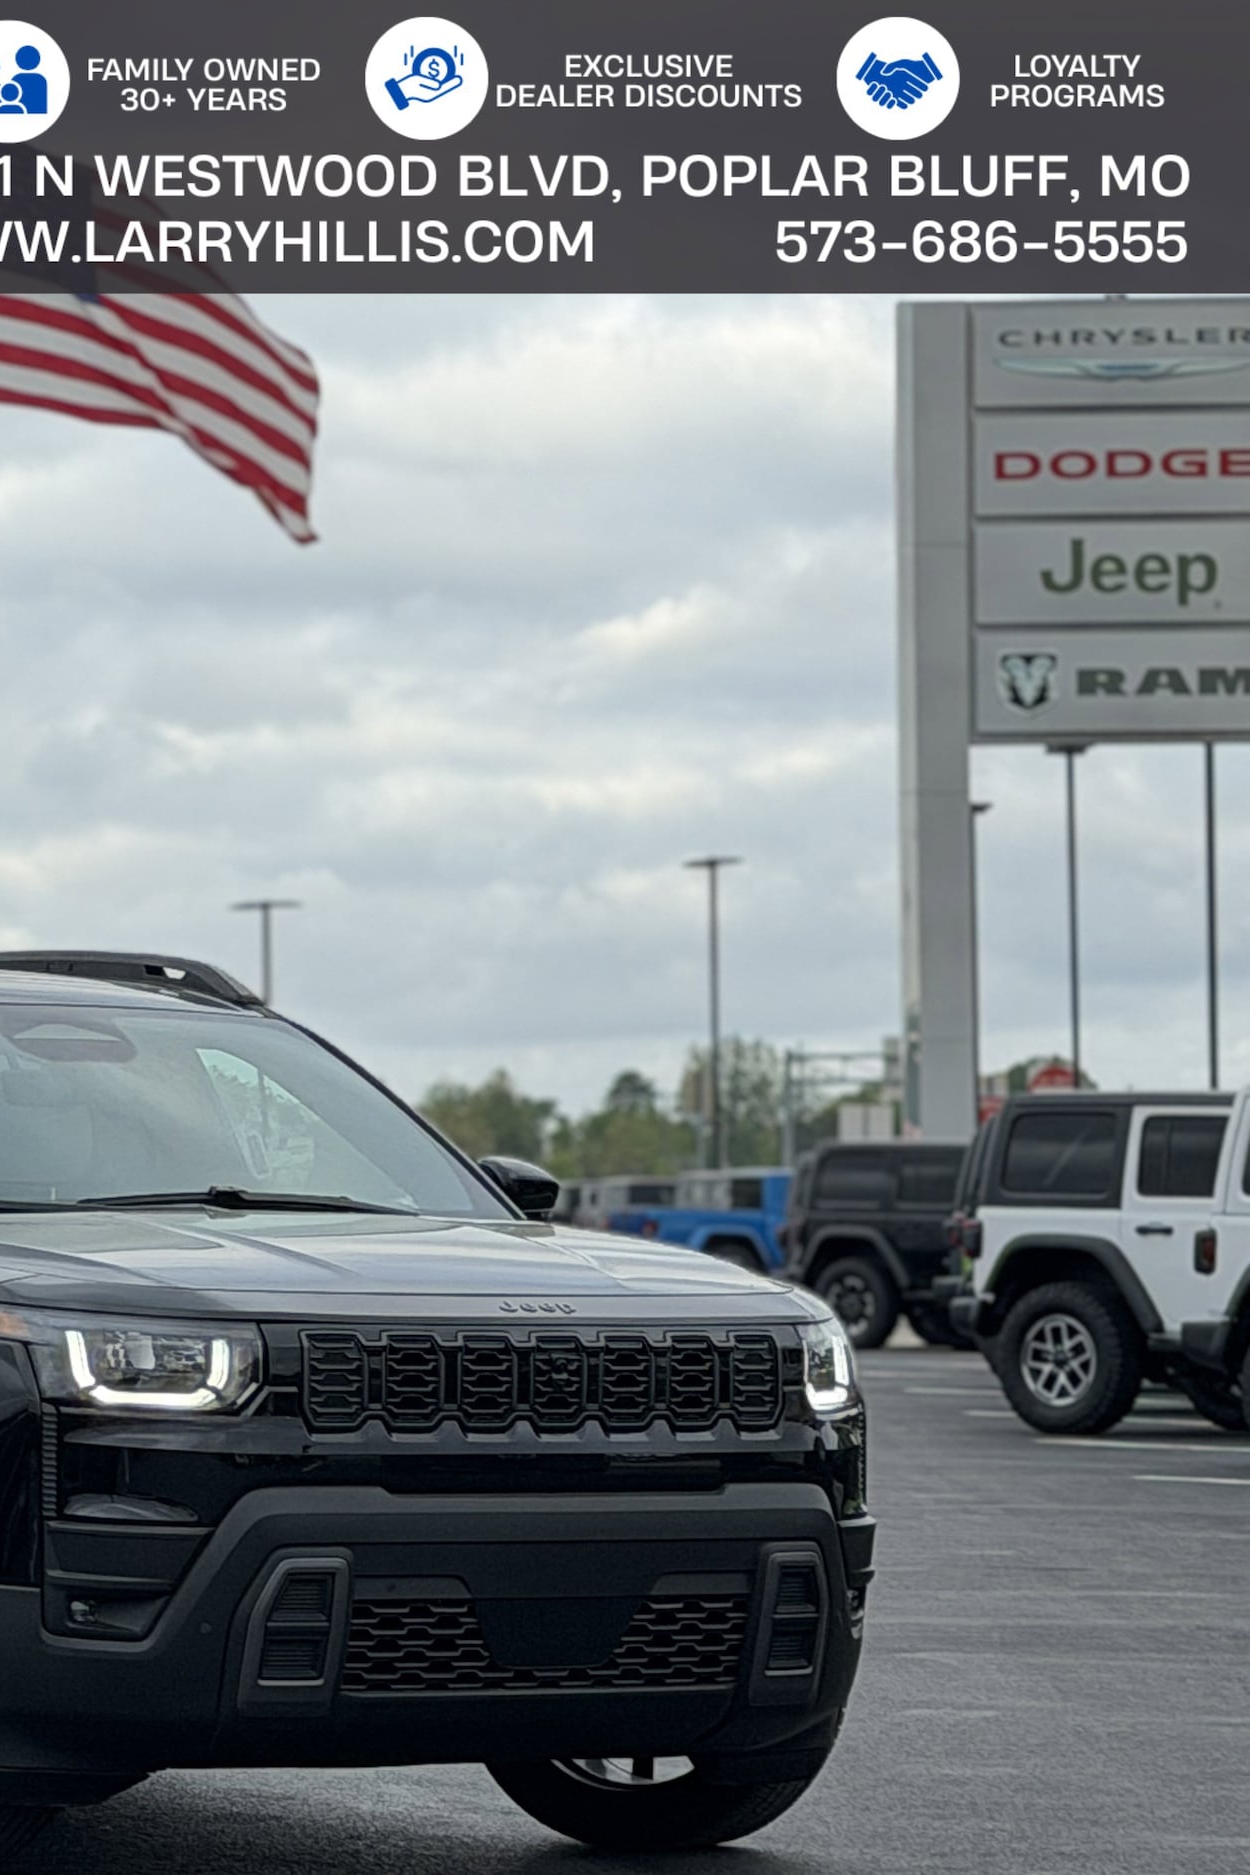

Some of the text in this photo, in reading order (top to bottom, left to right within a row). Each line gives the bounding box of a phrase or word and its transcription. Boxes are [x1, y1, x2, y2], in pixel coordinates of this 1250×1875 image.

[998, 327, 1250, 347] CHRYSLER
[995, 449, 1250, 480] DODGE
[1040, 538, 1217, 606] Jeep
[1076, 667, 1250, 696] RAM
[498, 1300, 577, 1315] Jeep
